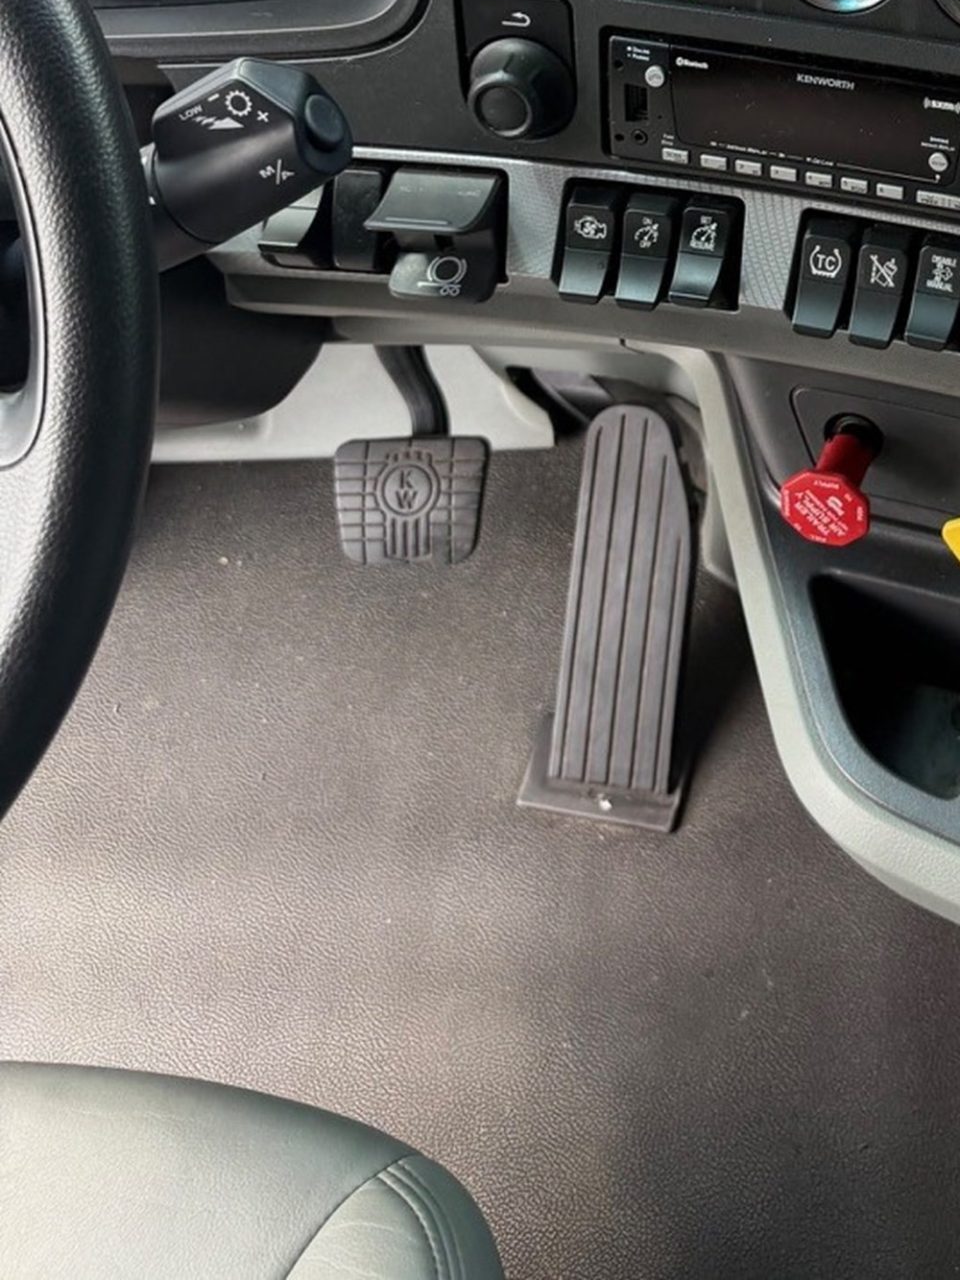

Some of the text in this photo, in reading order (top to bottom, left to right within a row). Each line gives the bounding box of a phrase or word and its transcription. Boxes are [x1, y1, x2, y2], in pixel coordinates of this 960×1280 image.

[796, 73, 855, 90] KENWORTH
[179, 104, 204, 120] LOW
[816, 253, 837, 270] TC
[401, 469, 413, 489] K
[395, 490, 418, 510] W
